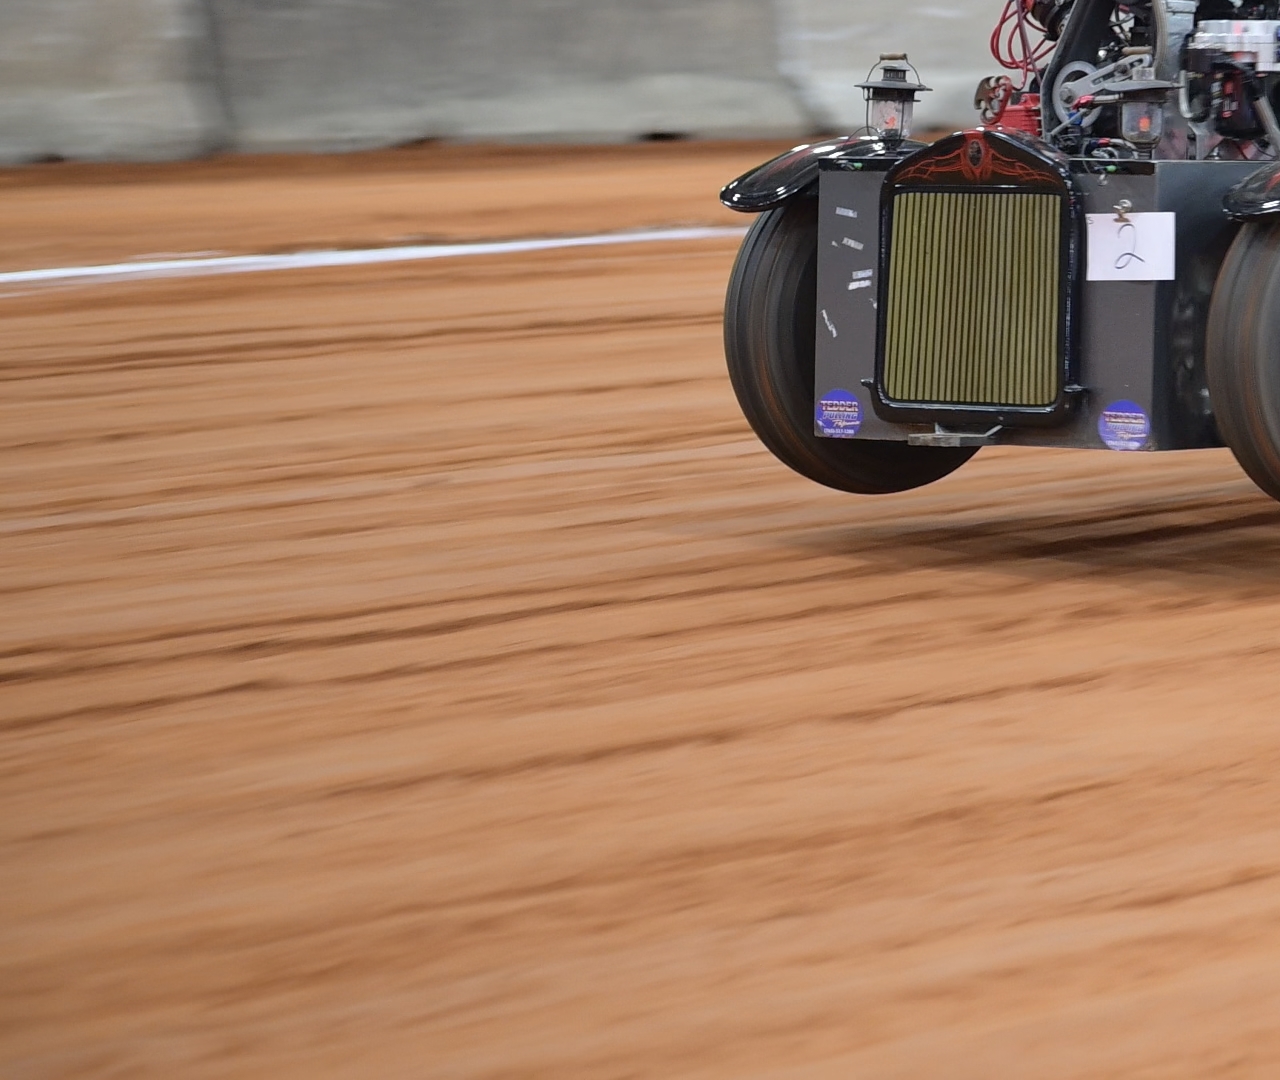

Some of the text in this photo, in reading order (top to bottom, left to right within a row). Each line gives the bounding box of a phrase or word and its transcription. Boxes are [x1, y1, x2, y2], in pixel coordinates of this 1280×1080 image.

[1115, 223, 1146, 270] 2
[820, 400, 858, 412] TEDDER
[822, 411, 859, 420] PULLING
